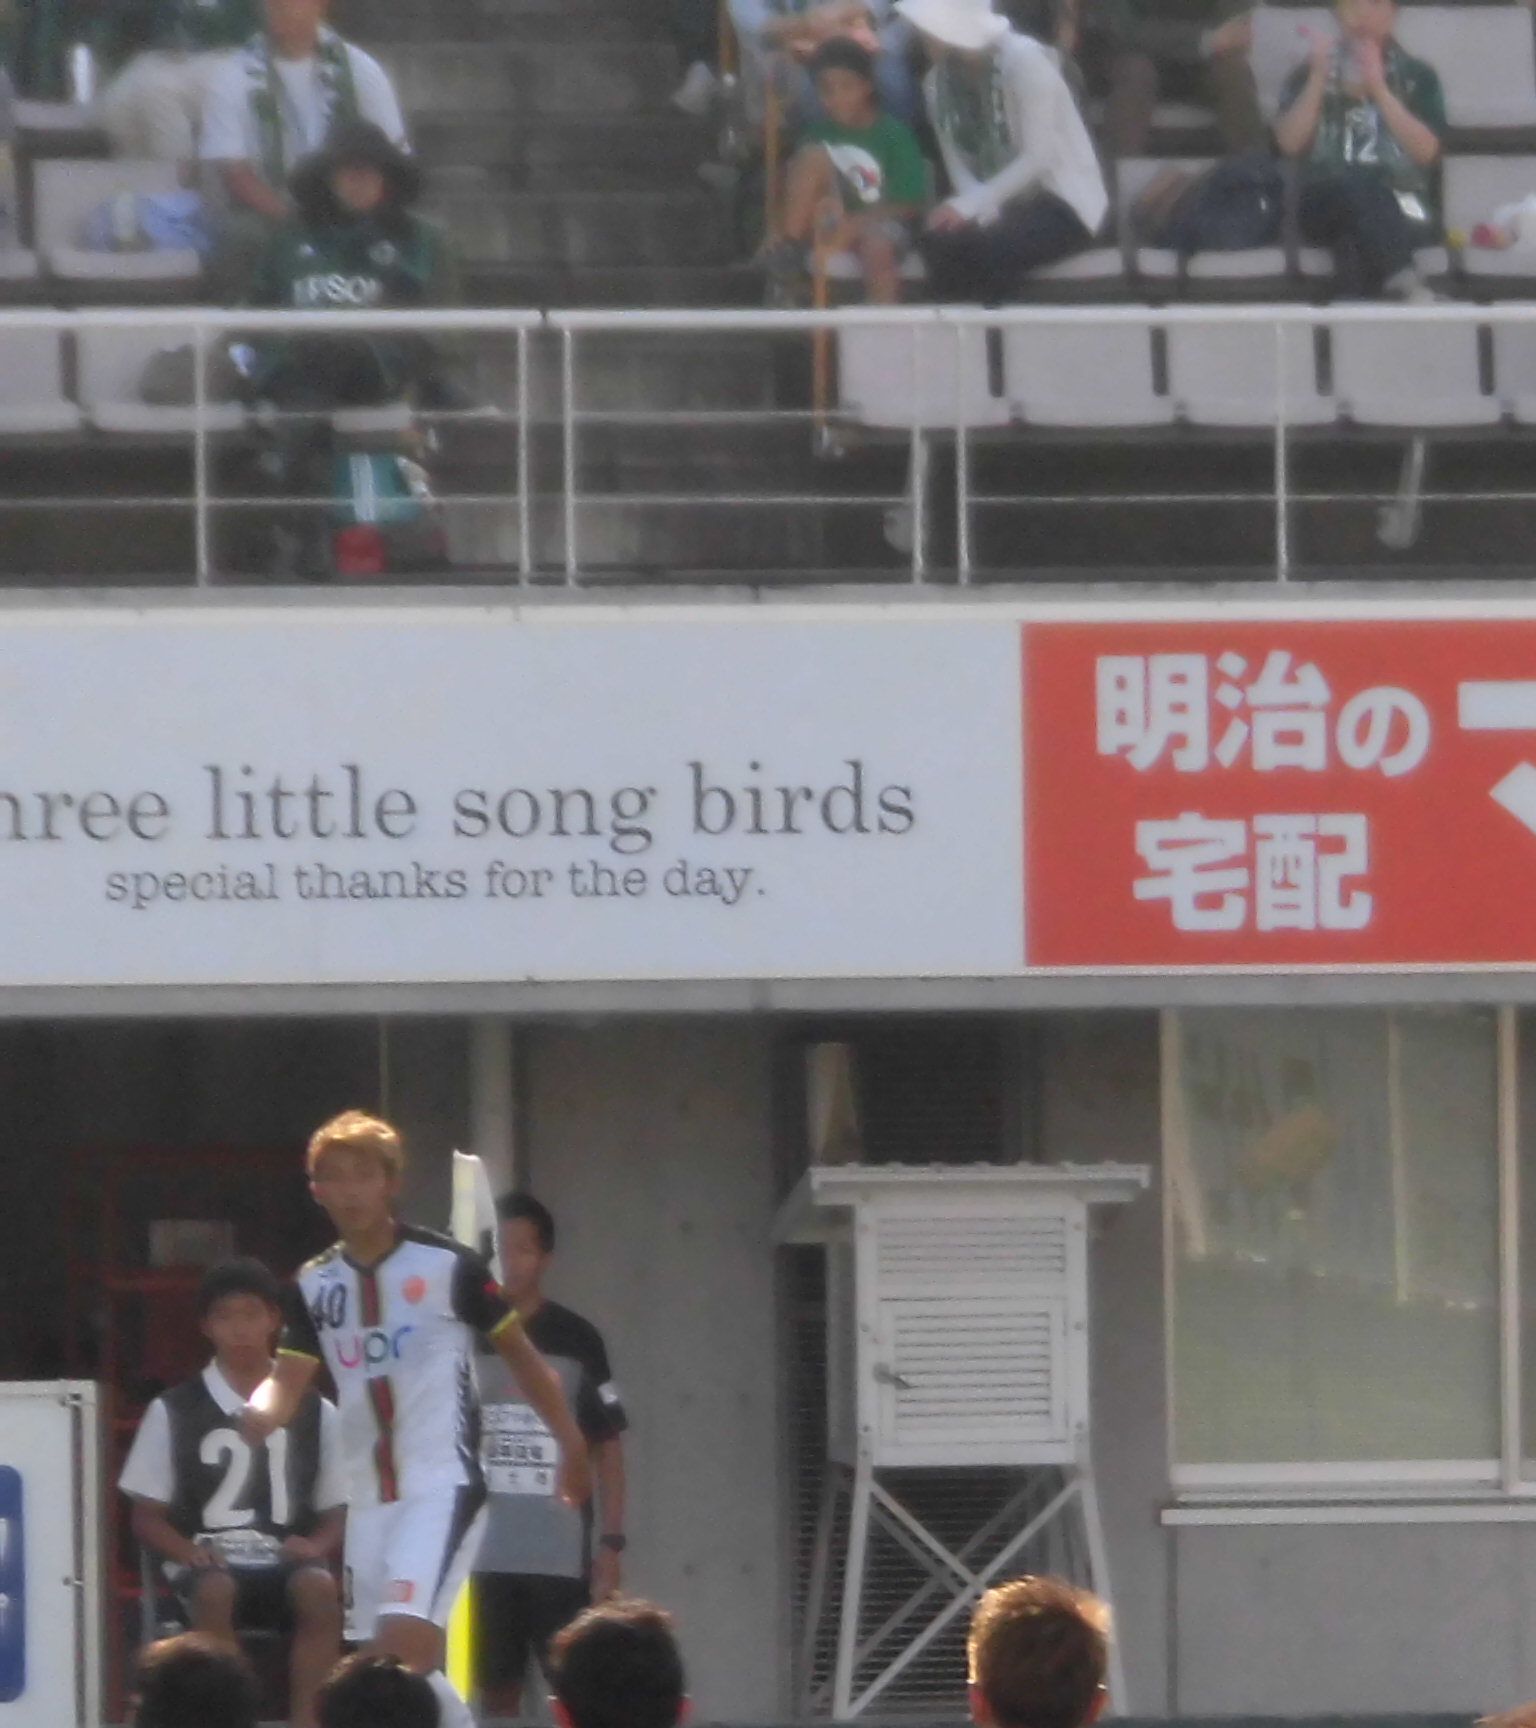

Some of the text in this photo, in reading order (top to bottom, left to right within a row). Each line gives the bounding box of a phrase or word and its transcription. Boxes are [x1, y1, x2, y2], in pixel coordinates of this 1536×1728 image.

[1096, 651, 1430, 777] 明治の
[204, 766, 417, 841] little
[453, 792, 658, 854] song
[690, 761, 916, 836] birds
[106, 857, 766, 910] special thanks for the day.
[1132, 812, 1373, 932] 宅配
[200, 1429, 289, 1528] 21
